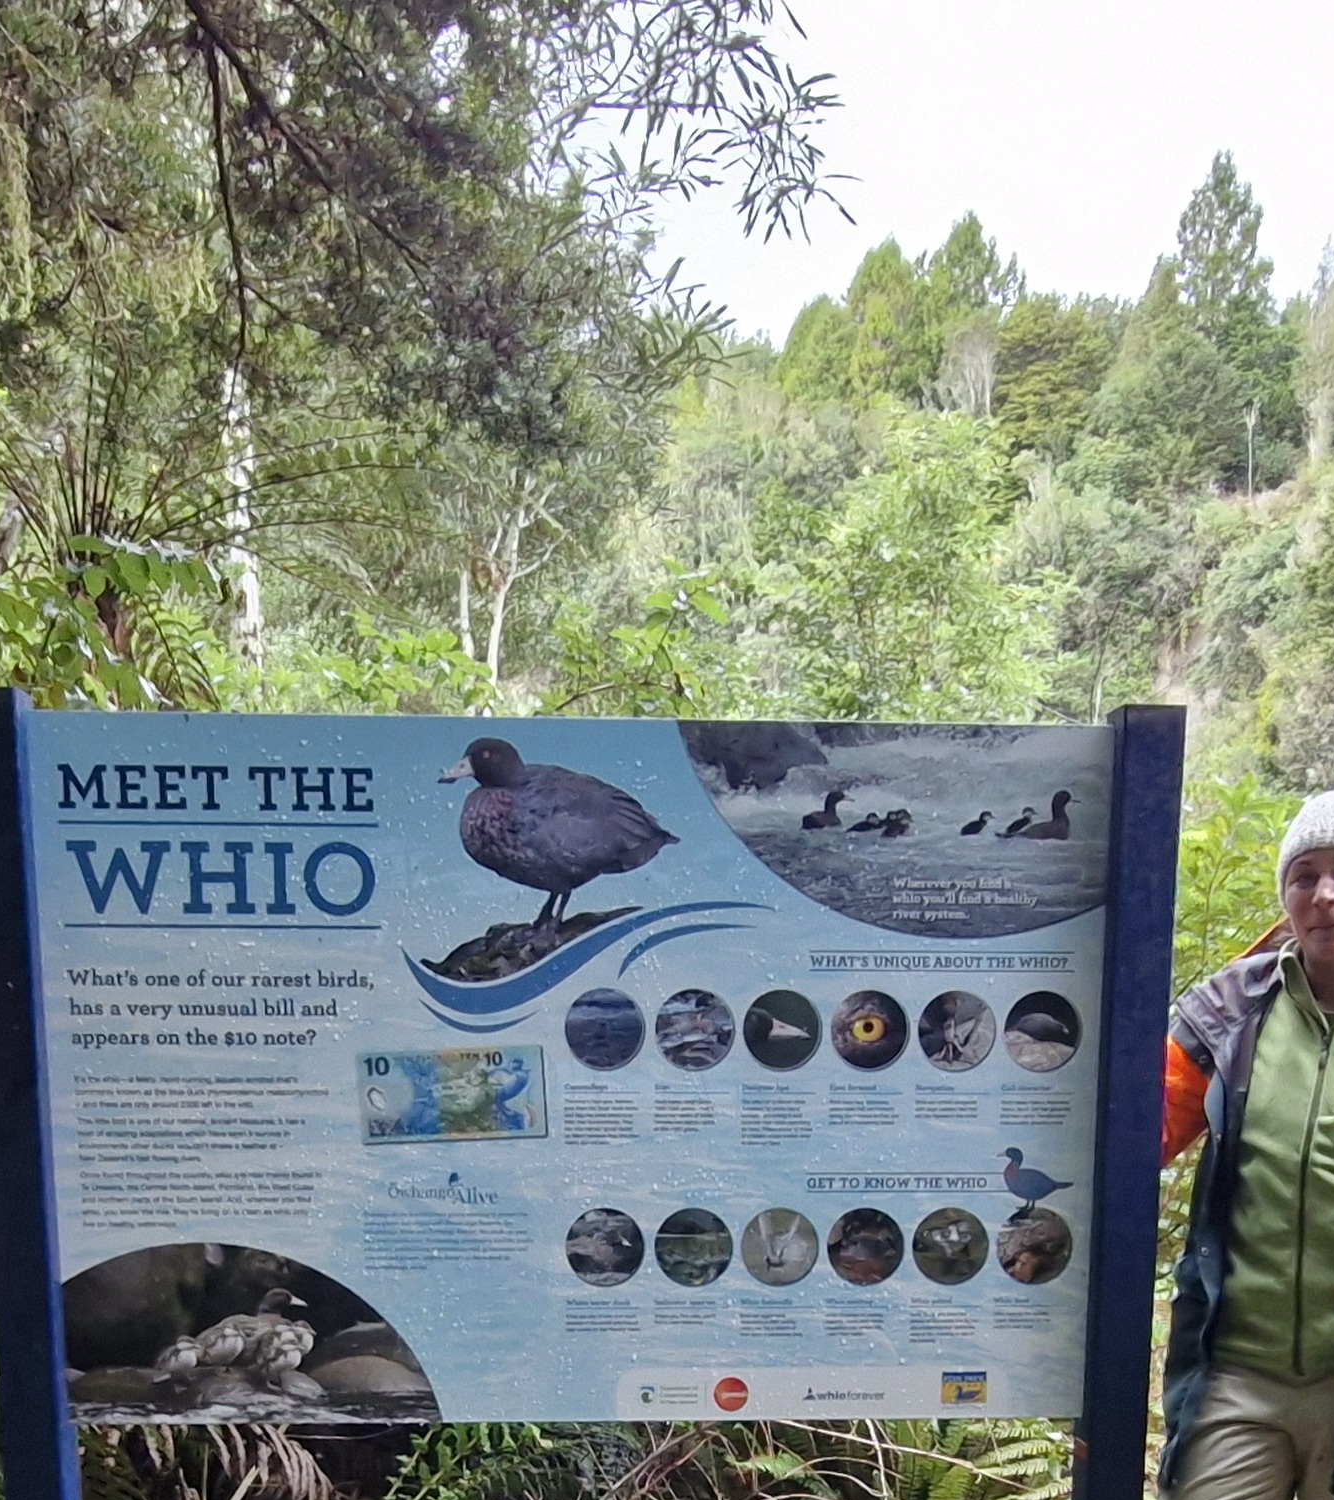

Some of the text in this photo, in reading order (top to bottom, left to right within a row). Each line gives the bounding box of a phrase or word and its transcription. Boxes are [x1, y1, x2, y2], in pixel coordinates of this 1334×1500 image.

[57, 763, 374, 812] MEET THE
[65, 840, 376, 917] WHIO
[893, 877, 952, 889] Wherever
[956, 880, 976, 891] you
[978, 877, 1003, 889] find
[892, 893, 921, 904] whio
[923, 893, 956, 906] you'll
[958, 893, 982, 905] find
[994, 893, 1039, 907] healthy
[892, 910, 970, 921] river system.
[810, 955, 1069, 970] WHAT'S UNIQUE ABOUT THE WHIO?
[67, 968, 375, 991] What's one of our rarest birds,
[69, 997, 338, 1020] has a very unusual bill and
[72, 1027, 317, 1049] appears on the $10 note?
[363, 1056, 390, 1076] 10
[483, 1051, 503, 1066] 10
[807, 1177, 988, 1189] GET TO KNOW THE WHIO
[453, 1186, 499, 1204] Alive
